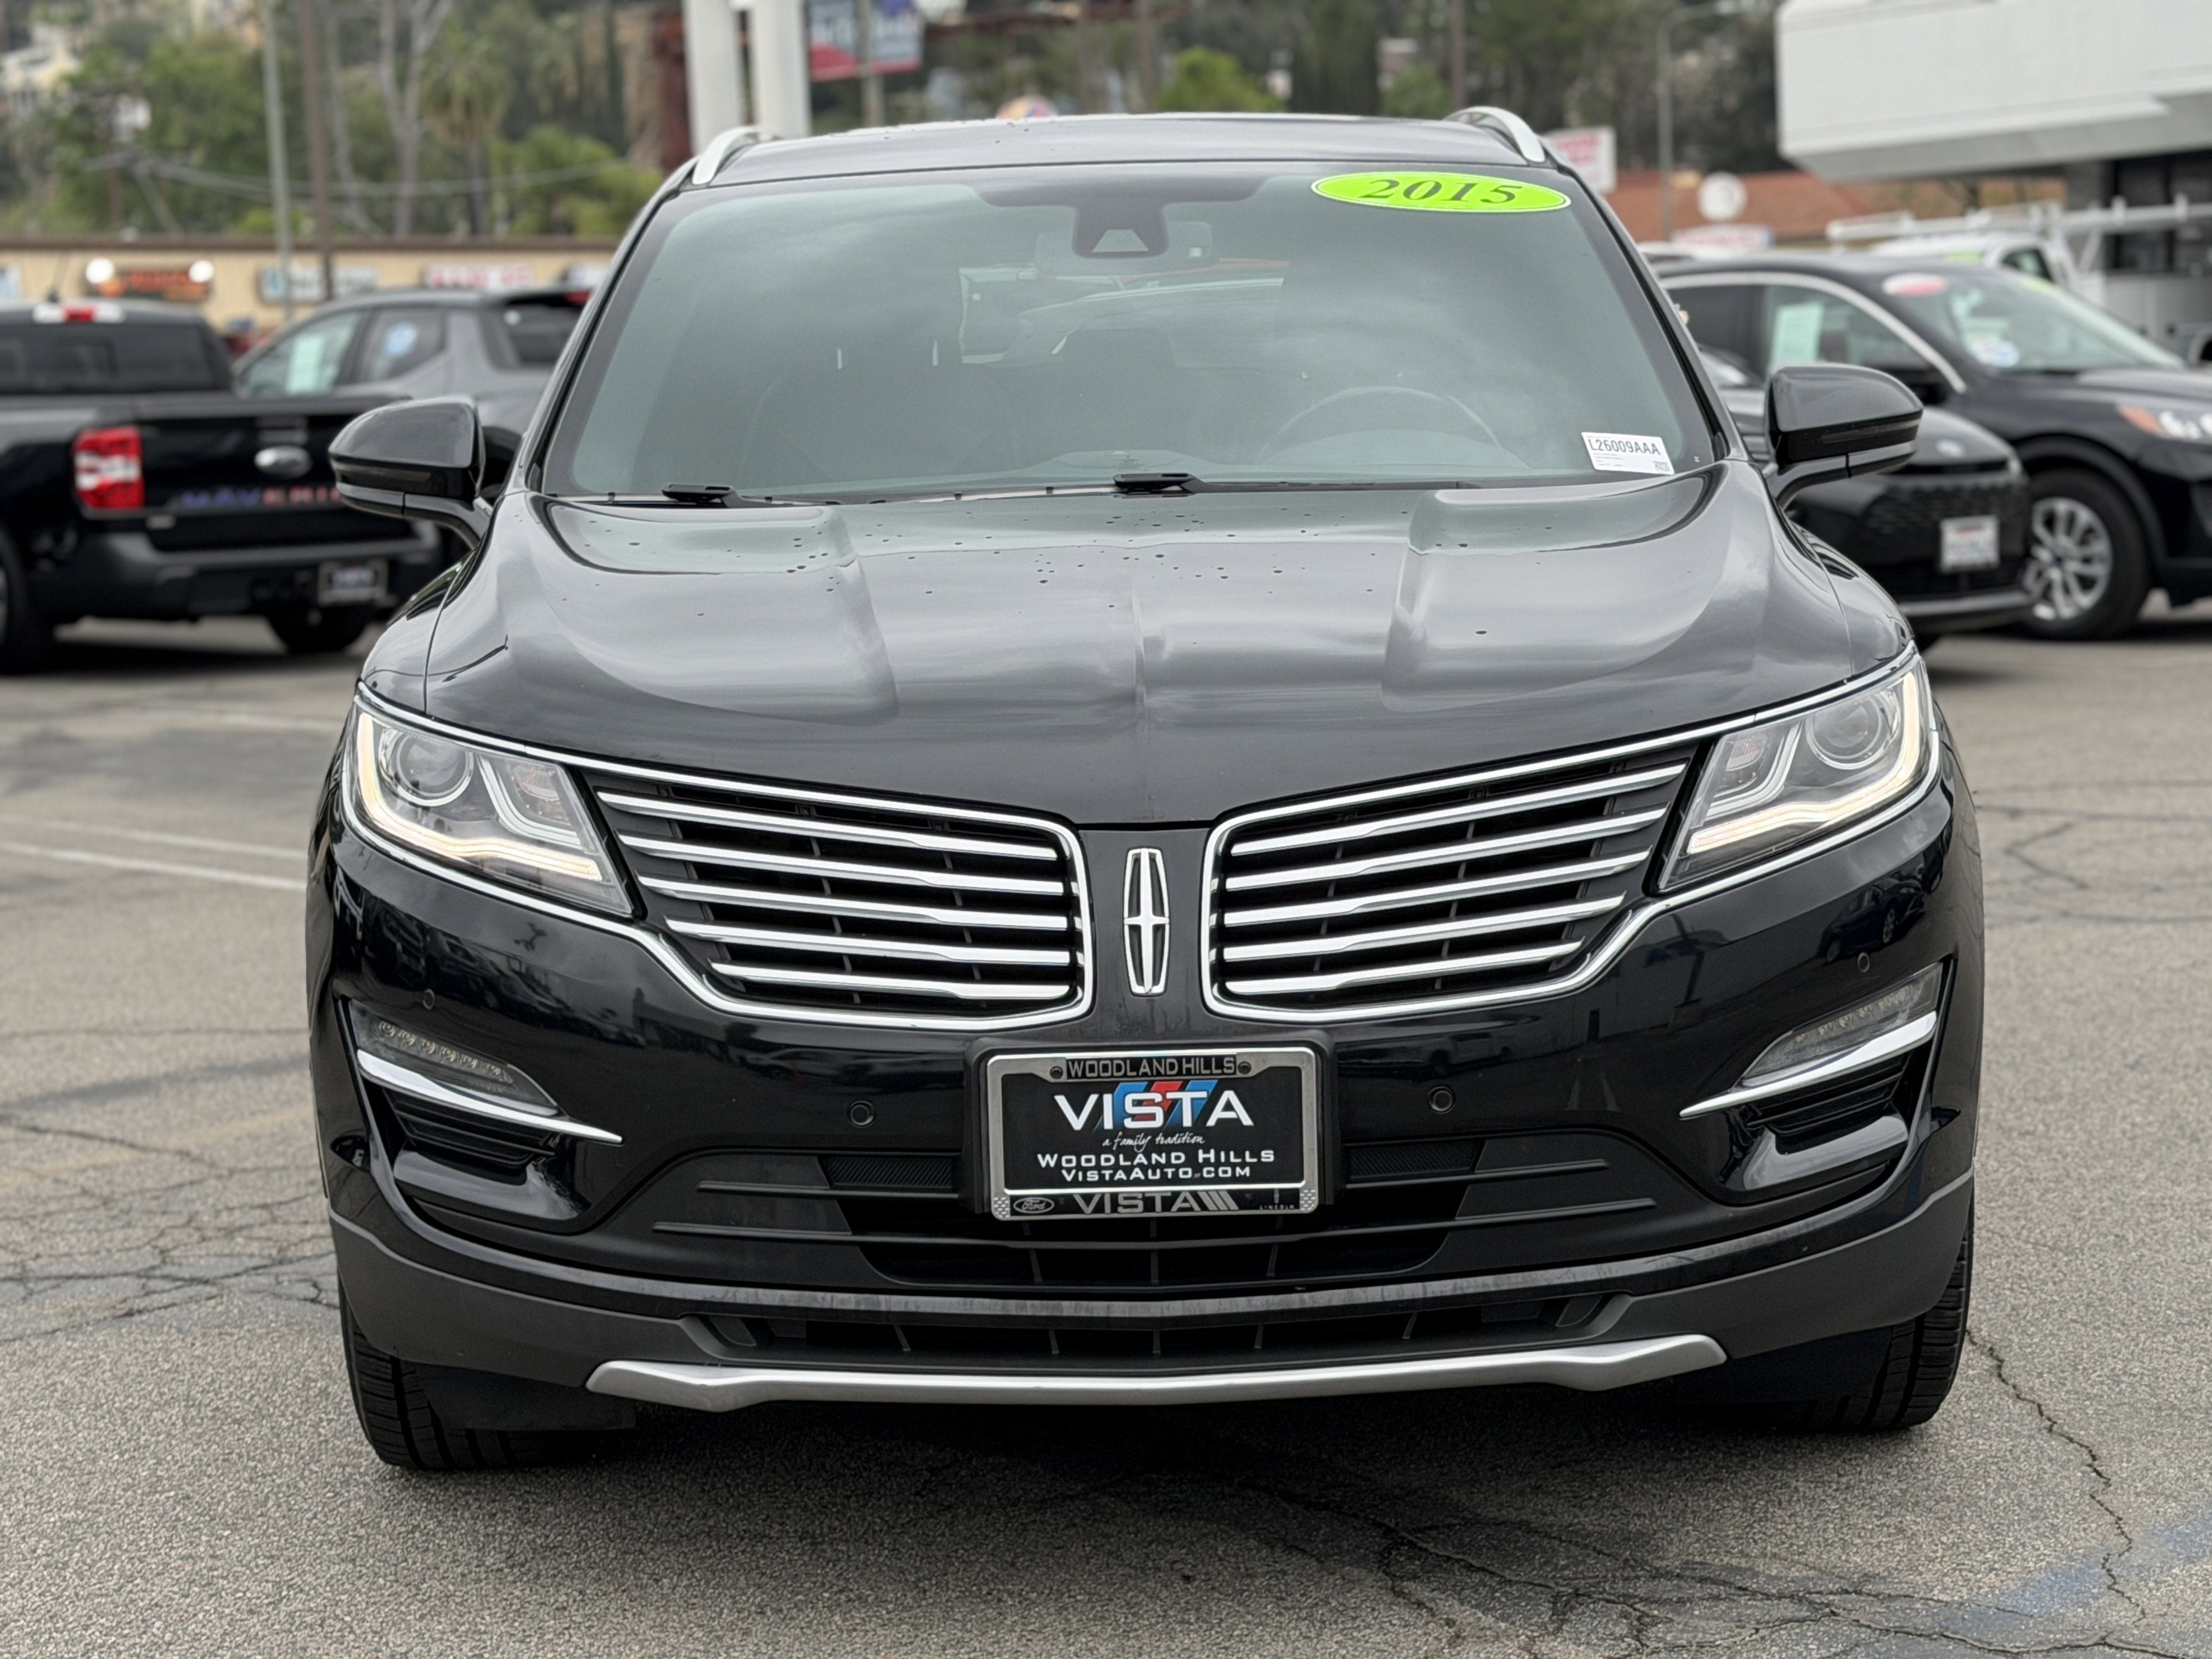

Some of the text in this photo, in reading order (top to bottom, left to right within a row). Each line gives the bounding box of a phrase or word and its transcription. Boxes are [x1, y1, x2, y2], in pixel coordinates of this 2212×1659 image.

[1358, 179, 1523, 204] 2015
[1587, 438, 1661, 455] L26009AAA
[1069, 1057, 1234, 1078] WOODLAND HILLS
[1053, 1090, 1255, 1131] VISTA
[1102, 1131, 1206, 1153] a family tradition
[1037, 1148, 1274, 1169] WOODLAND HILLS
[1073, 1191, 1201, 1214] VISTA
